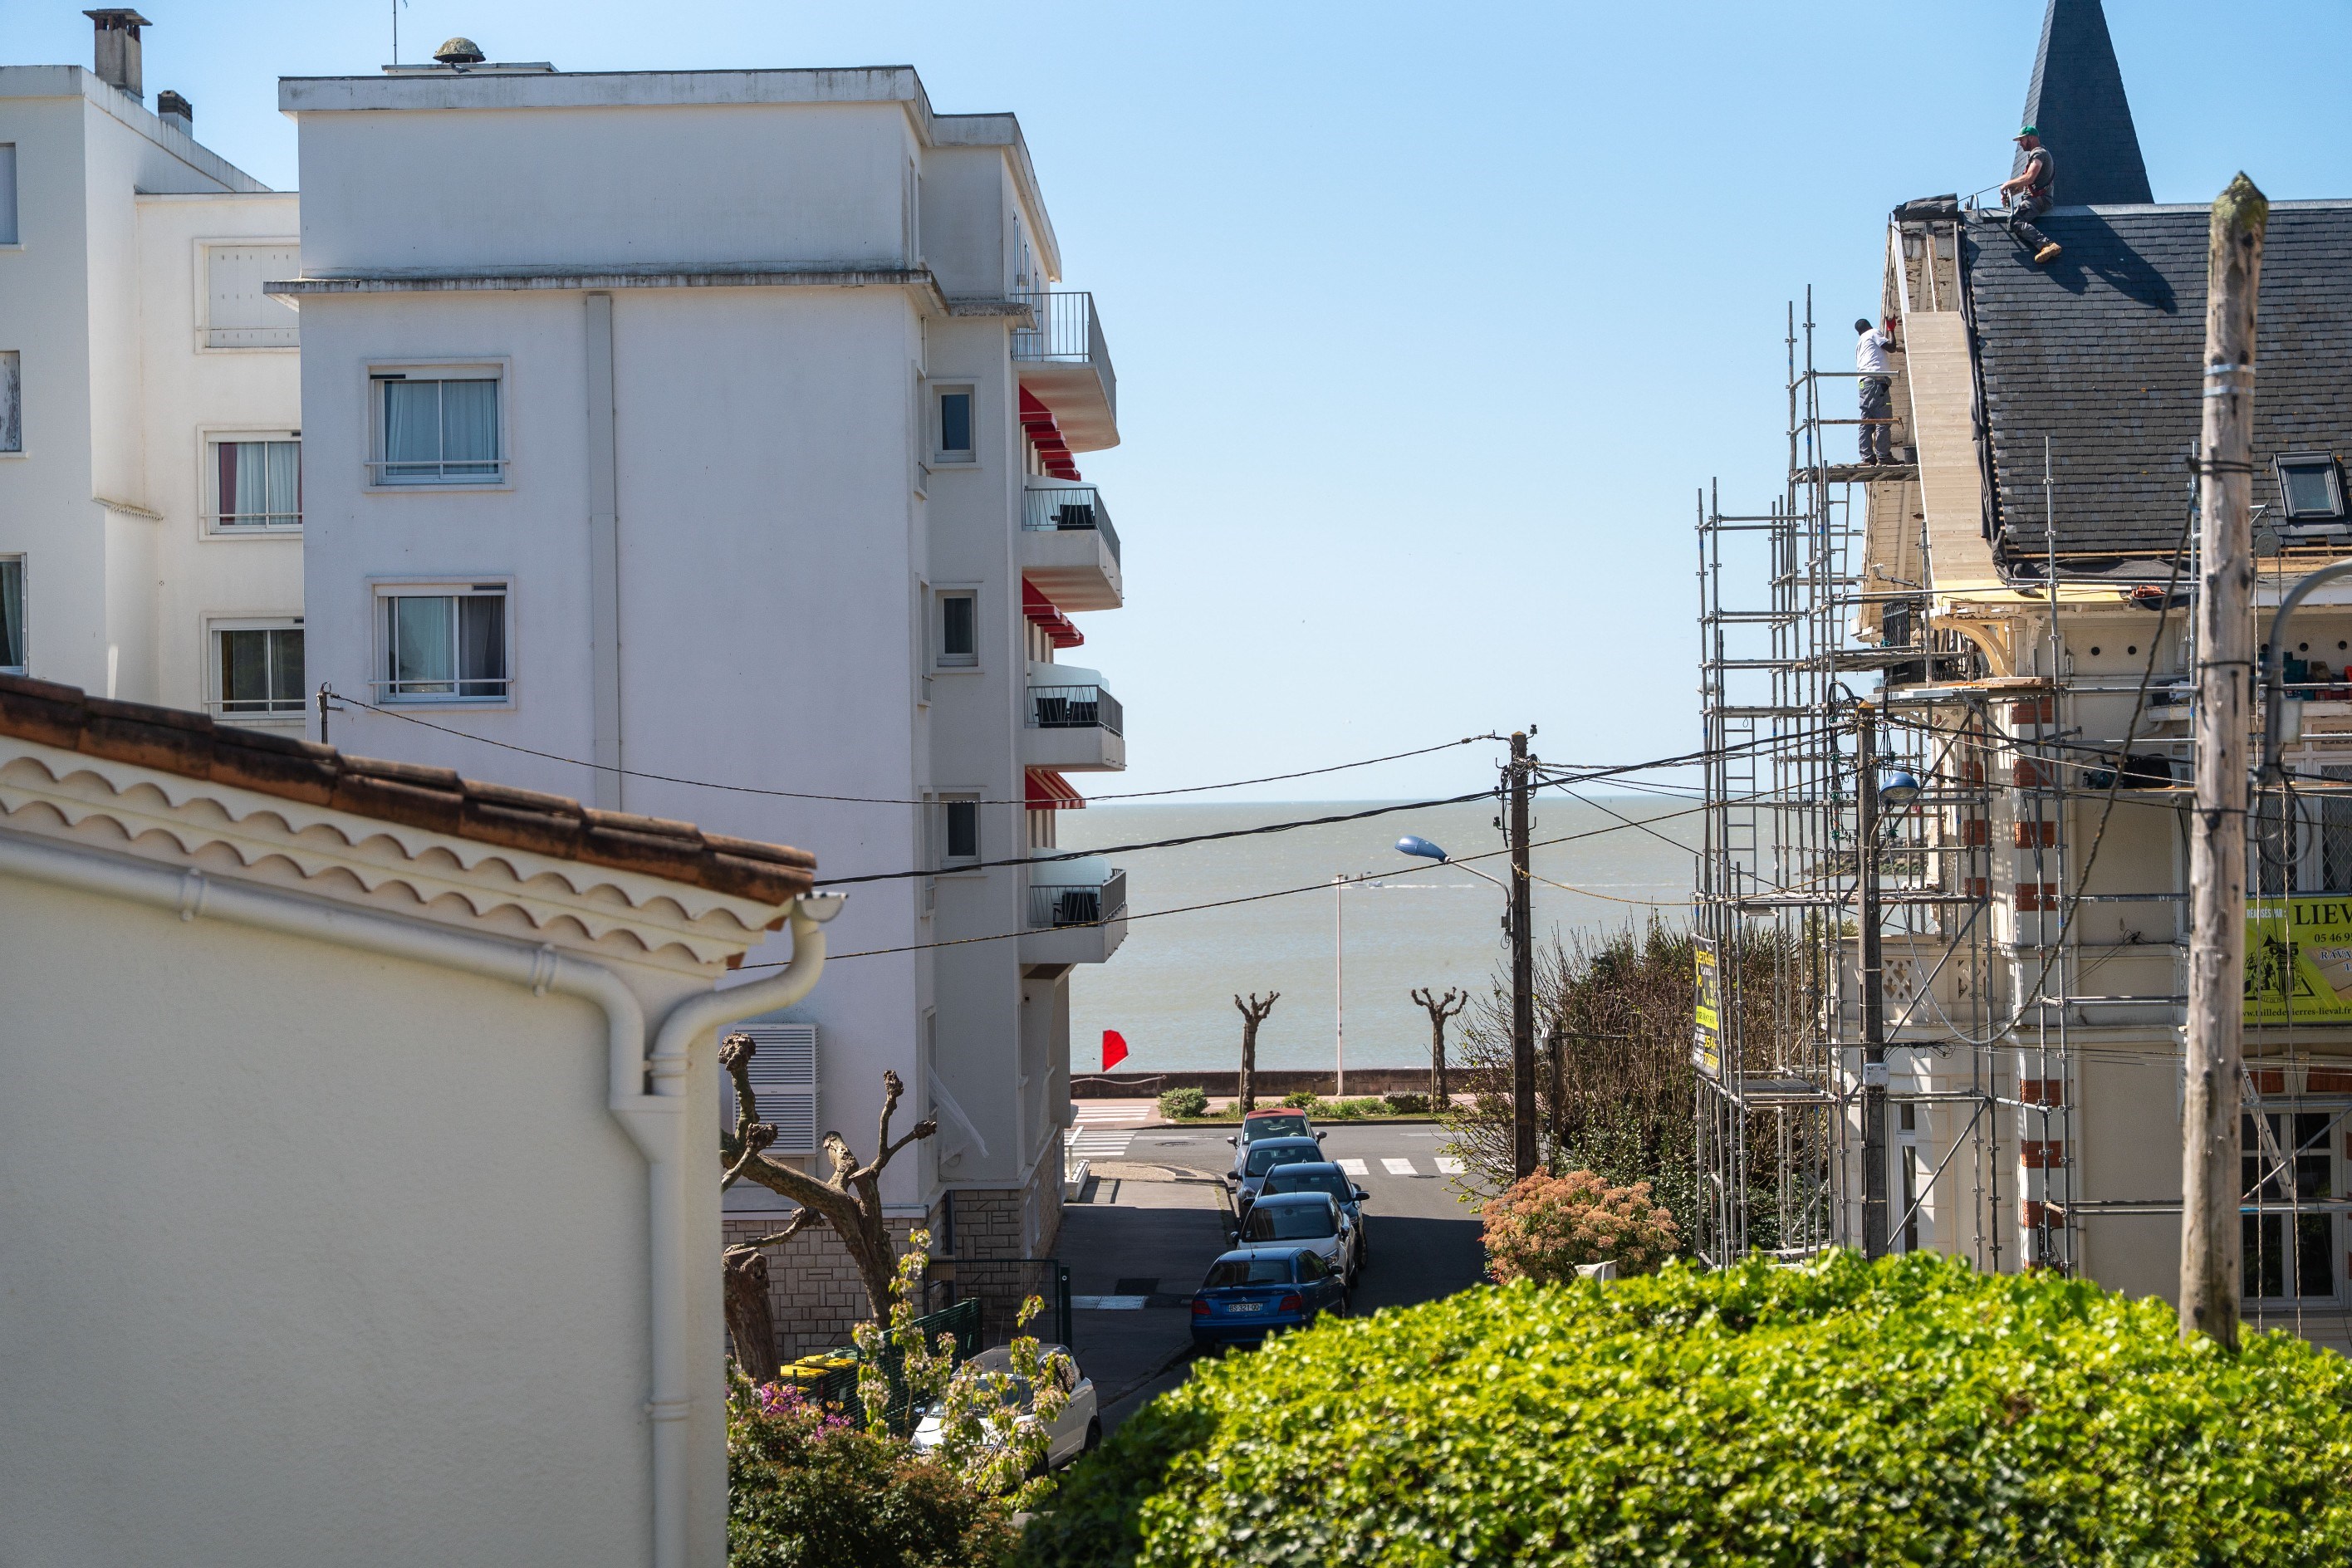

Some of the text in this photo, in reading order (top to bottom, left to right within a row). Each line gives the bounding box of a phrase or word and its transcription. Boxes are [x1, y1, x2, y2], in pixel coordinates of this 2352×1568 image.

[2247, 906, 2271, 919] RÉAISÉS
[2294, 904, 2352, 925] LIEV
[2314, 932, 2352, 943] 05 46 9
[2242, 1006, 2352, 1017] w.tilledeierres-lieval.fr
